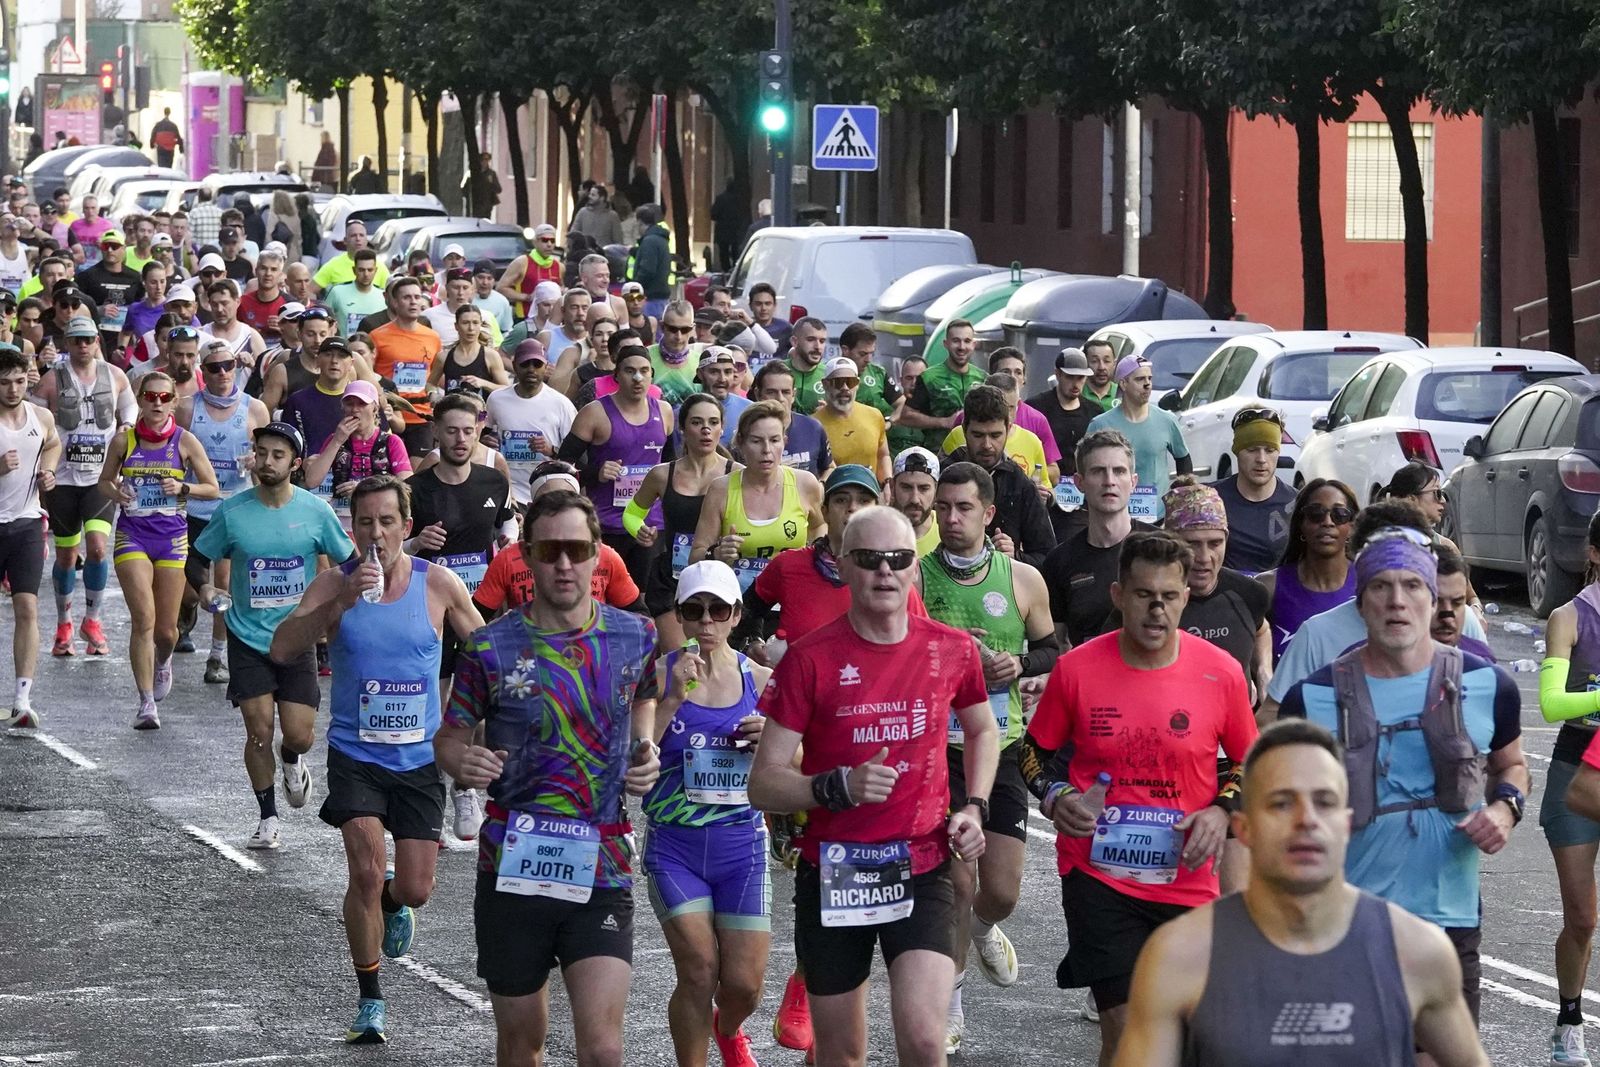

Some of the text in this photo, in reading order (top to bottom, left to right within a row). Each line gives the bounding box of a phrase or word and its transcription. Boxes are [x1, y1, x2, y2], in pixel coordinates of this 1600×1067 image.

[70, 454, 102, 463] ANTONIO
[505, 451, 536, 460] GERARD
[146, 476, 160, 484] ZUR
[140, 498, 168, 507] AGATA
[1057, 495, 1080, 504] RNAUD
[1128, 506, 1150, 514] LEXIS
[268, 559, 298, 568] ZURICH
[450, 555, 481, 565] ZURICH
[270, 575, 287, 583] 7924
[251, 582, 304, 596] XANKLY 11
[384, 683, 422, 692] ZURICH
[385, 702, 406, 711] 6117
[853, 700, 907, 715] GENERALI
[369, 715, 418, 728] CHESCO
[852, 723, 909, 744] MÁLAGA
[694, 772, 748, 787] MONICA
[1118, 777, 1176, 789] CLIMADIAZ
[1126, 810, 1174, 824] ZURICH
[539, 820, 590, 837] ZURICH
[1126, 833, 1152, 846] 7770
[537, 845, 564, 857] 8907
[852, 845, 900, 860] ZURICH
[1102, 846, 1169, 866] MANUEL
[519, 859, 575, 880] PJOTR
[853, 872, 881, 884] 4582
[830, 883, 905, 908] RICHARD
[1299, 1033, 1355, 1046] balance
